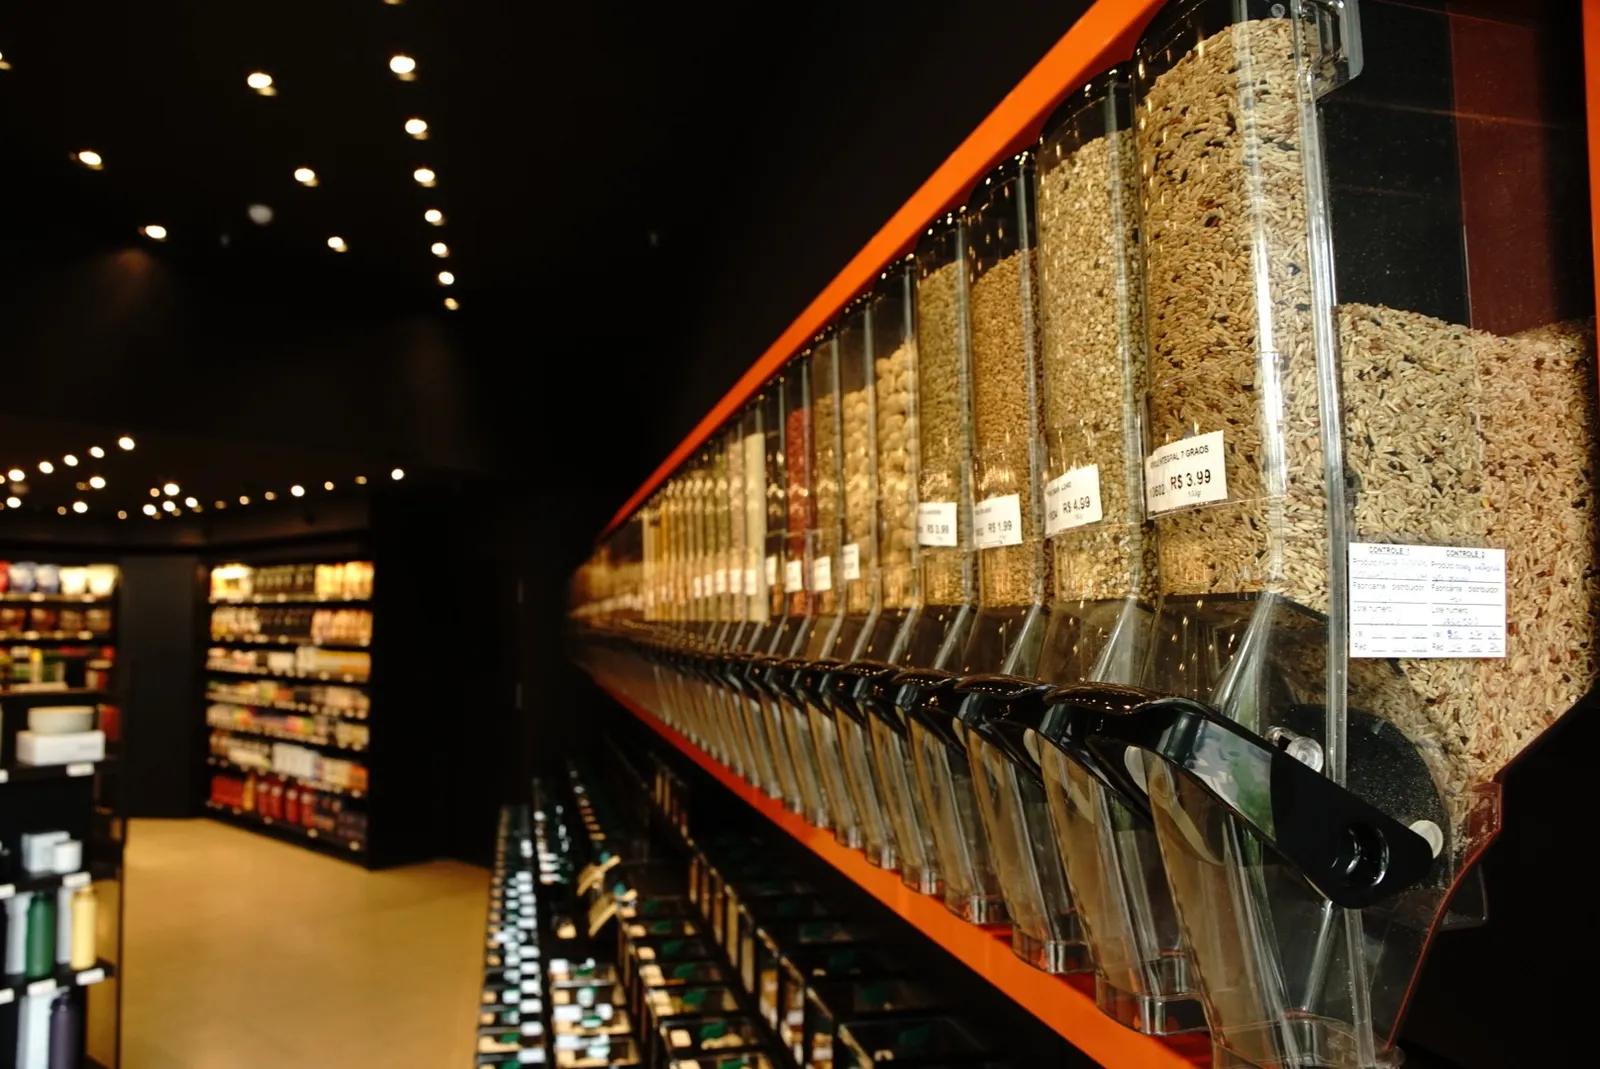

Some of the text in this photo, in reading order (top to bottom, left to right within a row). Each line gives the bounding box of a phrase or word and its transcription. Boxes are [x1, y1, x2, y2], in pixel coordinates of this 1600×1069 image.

[1181, 450, 1184, 458] 7
[1185, 445, 1209, 457] GRAOS
[1170, 474, 1183, 490] R$
[1186, 469, 1211, 487] 3.99
[1063, 496, 1091, 514] R$ 4.99
[988, 522, 996, 533] R$
[997, 520, 1012, 532] 1.99
[1369, 546, 1403, 555] CONTROLE
[1446, 549, 1479, 558] CONTROLE
